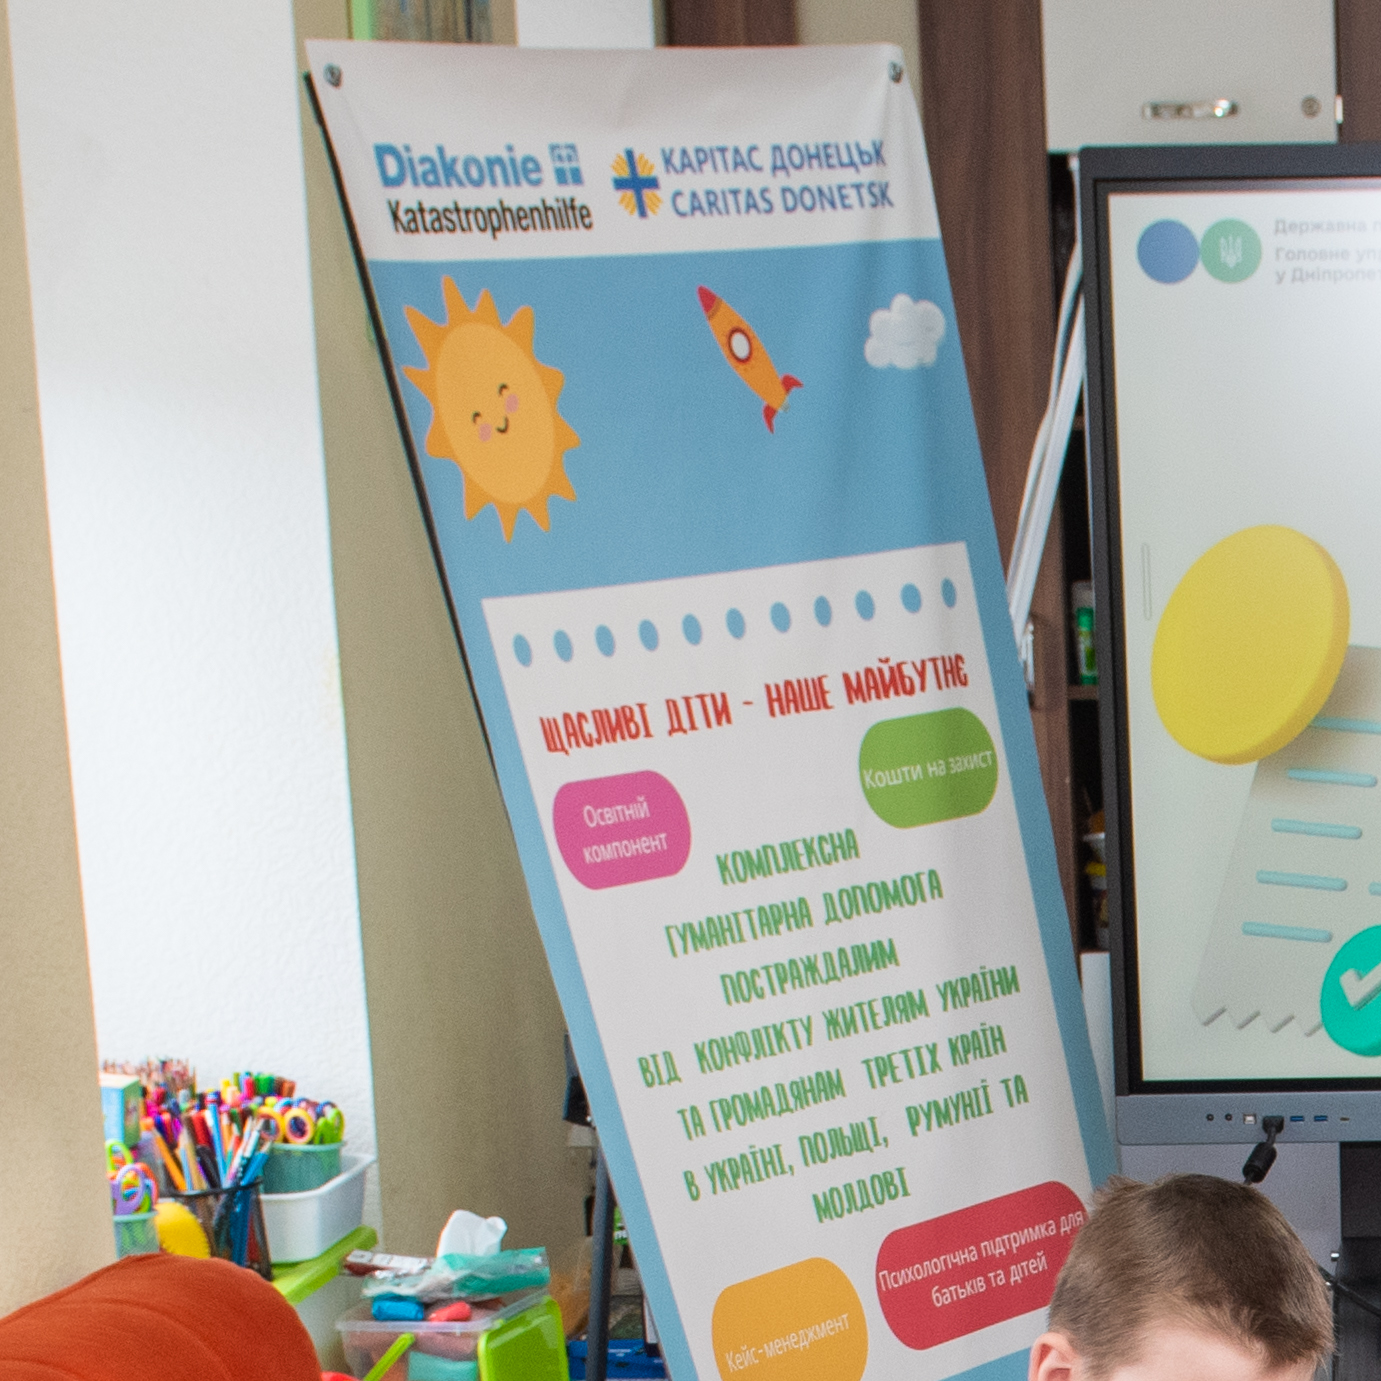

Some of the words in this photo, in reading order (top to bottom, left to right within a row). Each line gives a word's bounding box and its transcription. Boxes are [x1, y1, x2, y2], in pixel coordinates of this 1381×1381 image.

[374, 142, 543, 188] Diakonie
[661, 143, 764, 178] КАРІТАС
[770, 139, 886, 178] ДОНЕЦЬК
[386, 196, 594, 239] Katastrophenhilfe
[671, 185, 775, 218] CARITAS
[781, 181, 895, 212] DONETSK
[539, 703, 655, 755] ЩАСЛИВІ
[667, 692, 733, 737] ДІТИ
[764, 674, 835, 718] НАШЕ
[841, 652, 970, 708] МАЙБУТНЄ
[863, 763, 924, 790] Кошти
[927, 756, 947, 778] на
[949, 747, 994, 775] захист
[583, 795, 651, 828] Освітній
[583, 831, 669, 865] компонент
[716, 829, 860, 886] КОМПЛЕКСНА
[665, 896, 814, 958] ГУМАНІТАРНА
[822, 869, 944, 926] ДОПОМОГА
[720, 938, 901, 1006] ПОСТРАЖДАЛИМ
[638, 1051, 682, 1089] ВІД
[693, 1016, 815, 1075] КОНФЛІКТУ
[822, 990, 930, 1042] ЖИТЕЛЯМ
[936, 965, 1021, 1013] УКРАЇНИ
[677, 1105, 707, 1142] ТА
[708, 1067, 846, 1134] ГРОМАДЯНАМ
[862, 1042, 943, 1089] ТРЕТІХ
[947, 1024, 1008, 1067] КРАЇН
[683, 1170, 702, 1201] В
[703, 1143, 795, 1196] УКРАЇНІ,
[798, 1115, 890, 1169] ПОЛЬЩІ,
[905, 1082, 995, 1138] РУМУНІЇ
[1000, 1074, 1030, 1106] ТА
[812, 1167, 912, 1223] МОЛДОВІ
[878, 1245, 979, 1293] Психологічна
[981, 1219, 1058, 1260] підтримка
[1058, 1209, 1086, 1237] для
[931, 1277, 987, 1308] батьків
[987, 1269, 1007, 1288] та
[1009, 1252, 1049, 1284] дітей
[725, 1313, 851, 1374] Кейс-менеджмент
